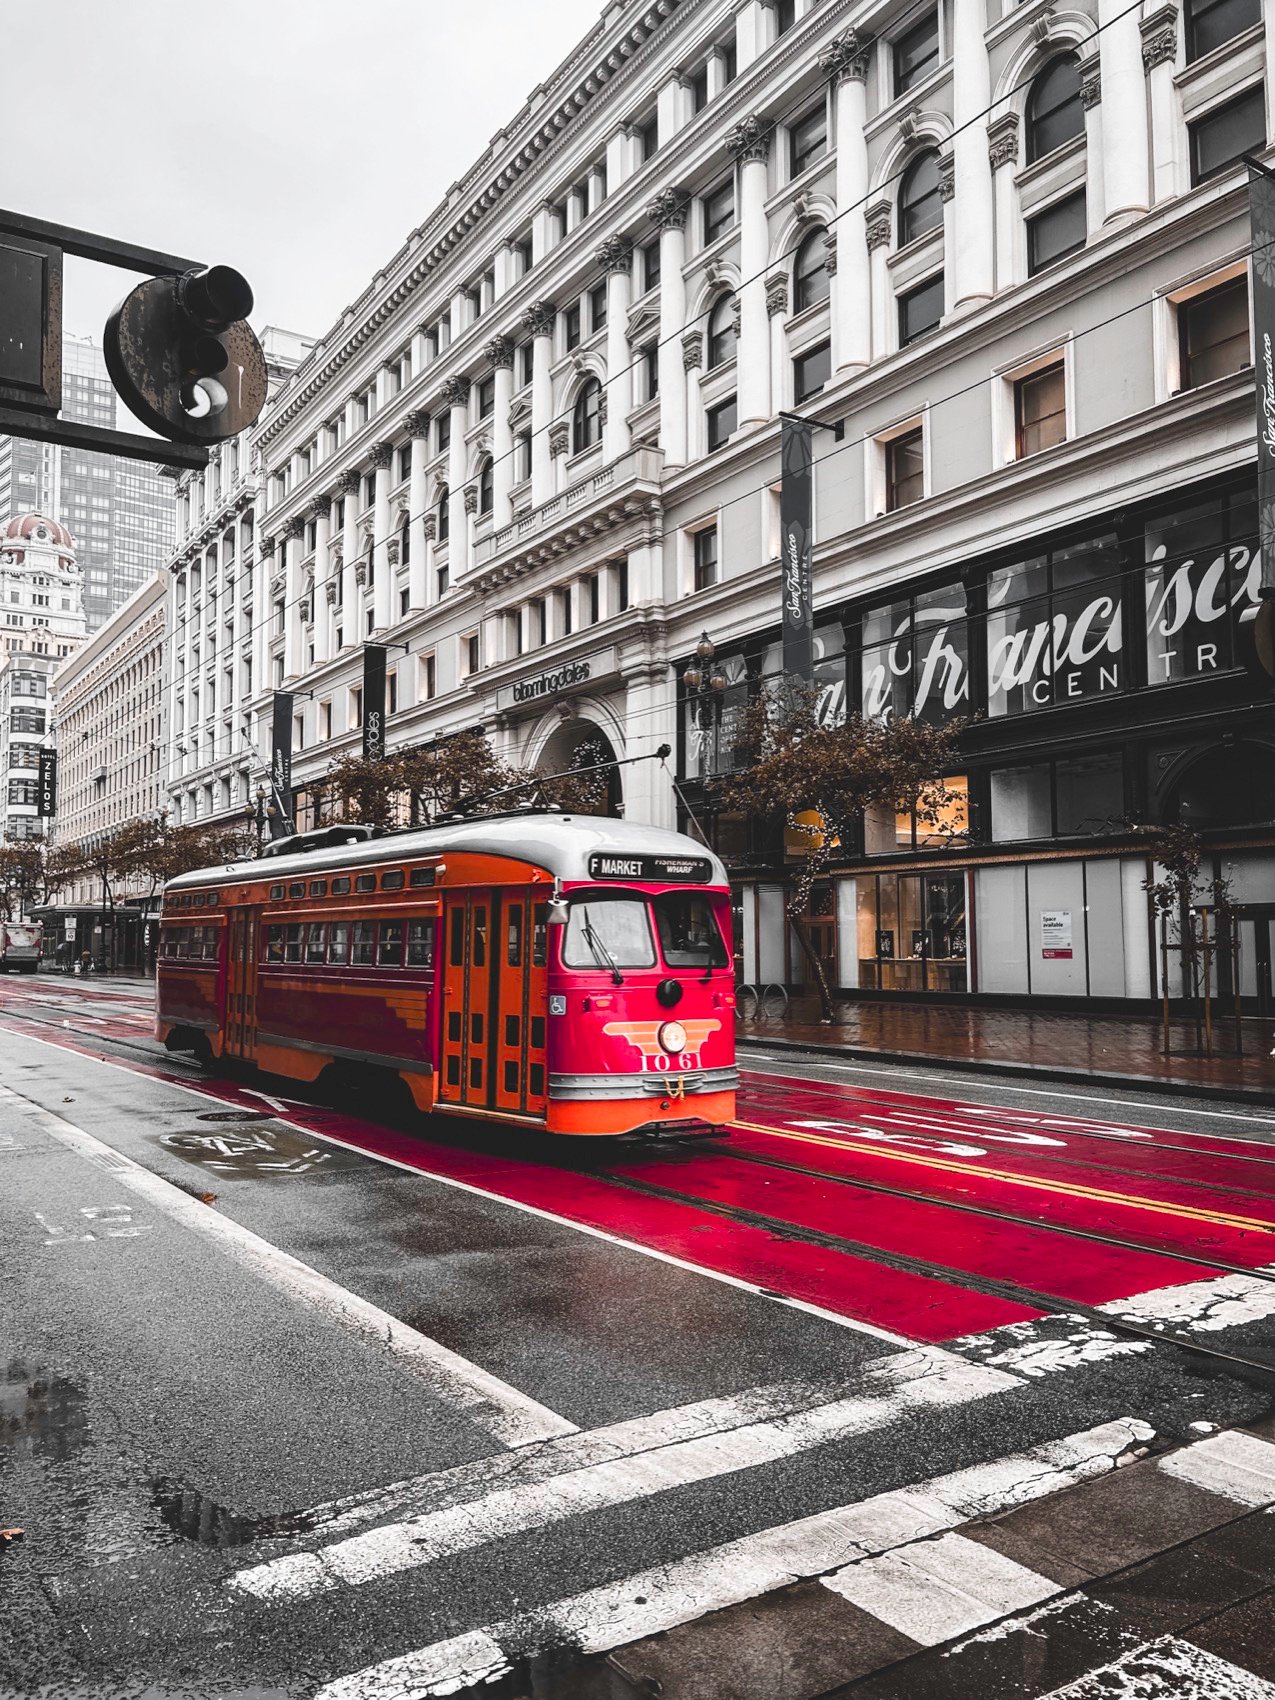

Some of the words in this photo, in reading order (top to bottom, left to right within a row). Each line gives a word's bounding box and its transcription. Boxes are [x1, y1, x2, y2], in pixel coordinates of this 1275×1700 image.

[785, 533, 801, 594] Francisco
[786, 591, 801, 618] San
[1032, 643, 1217, 704] CENTR
[43, 761, 51, 811] ZELOS
[591, 859, 598, 873] F
[601, 859, 643, 875] MARKET
[654, 859, 705, 867] FISHERMANS
[666, 865, 693, 874] WHARF
[639, 1053, 702, 1072] 1061
